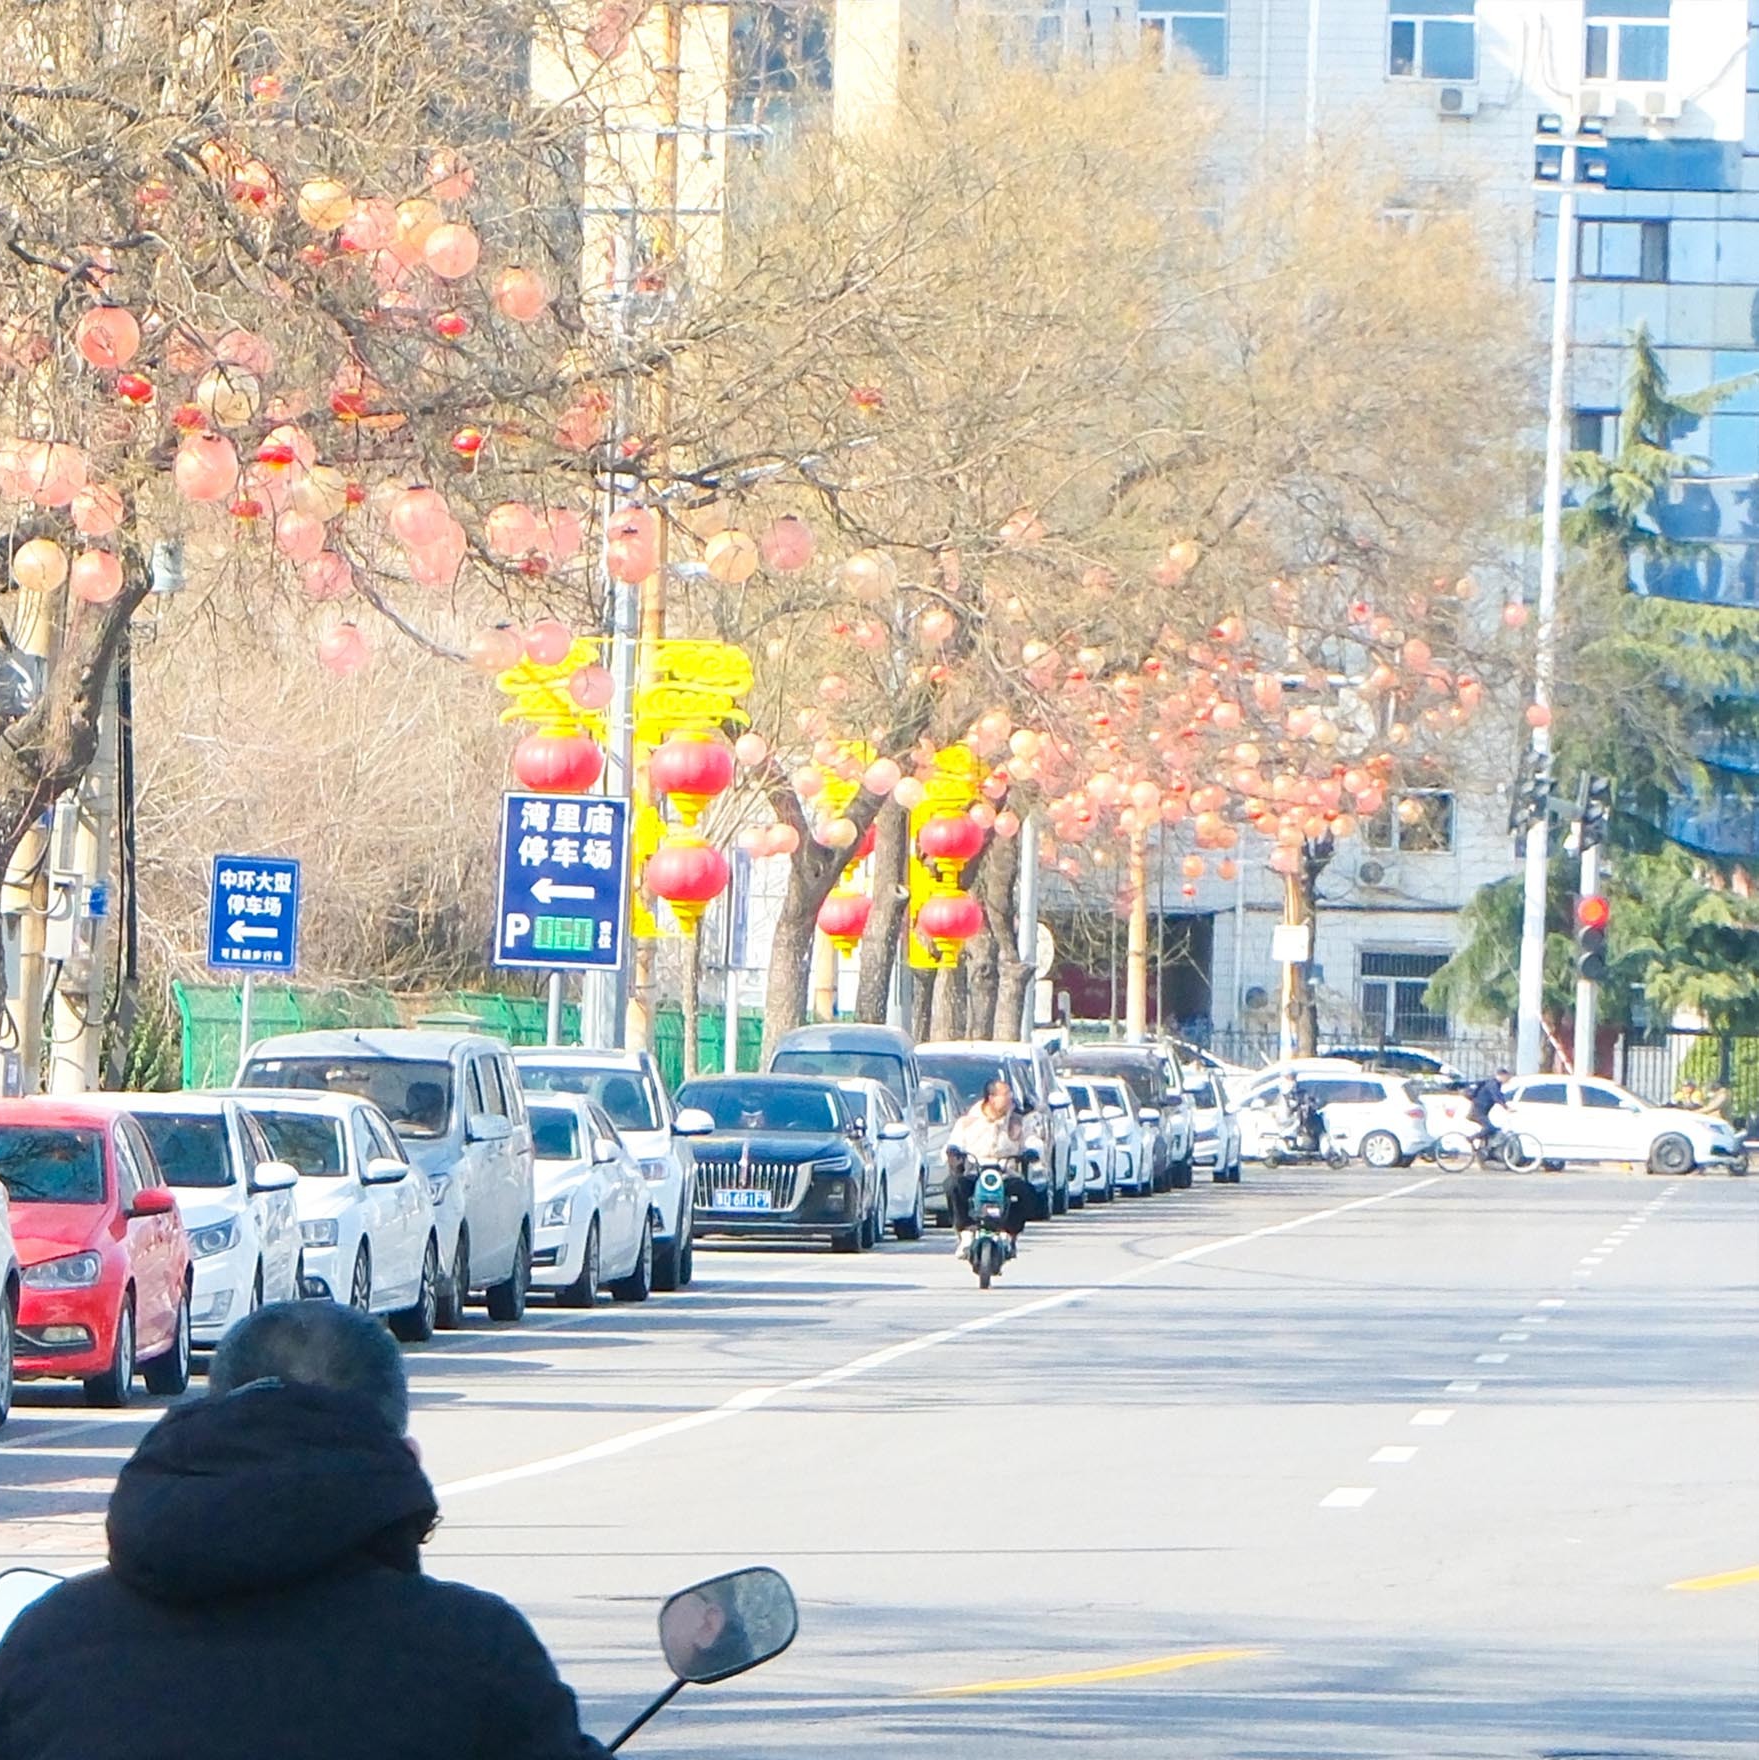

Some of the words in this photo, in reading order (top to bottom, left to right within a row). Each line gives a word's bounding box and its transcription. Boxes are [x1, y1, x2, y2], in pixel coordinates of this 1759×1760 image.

[520, 801, 614, 835] 湾里庙
[518, 835, 613, 870] 停车场
[219, 868, 292, 893] 中环大型
[227, 894, 282, 917] 停车场
[504, 912, 530, 948] P
